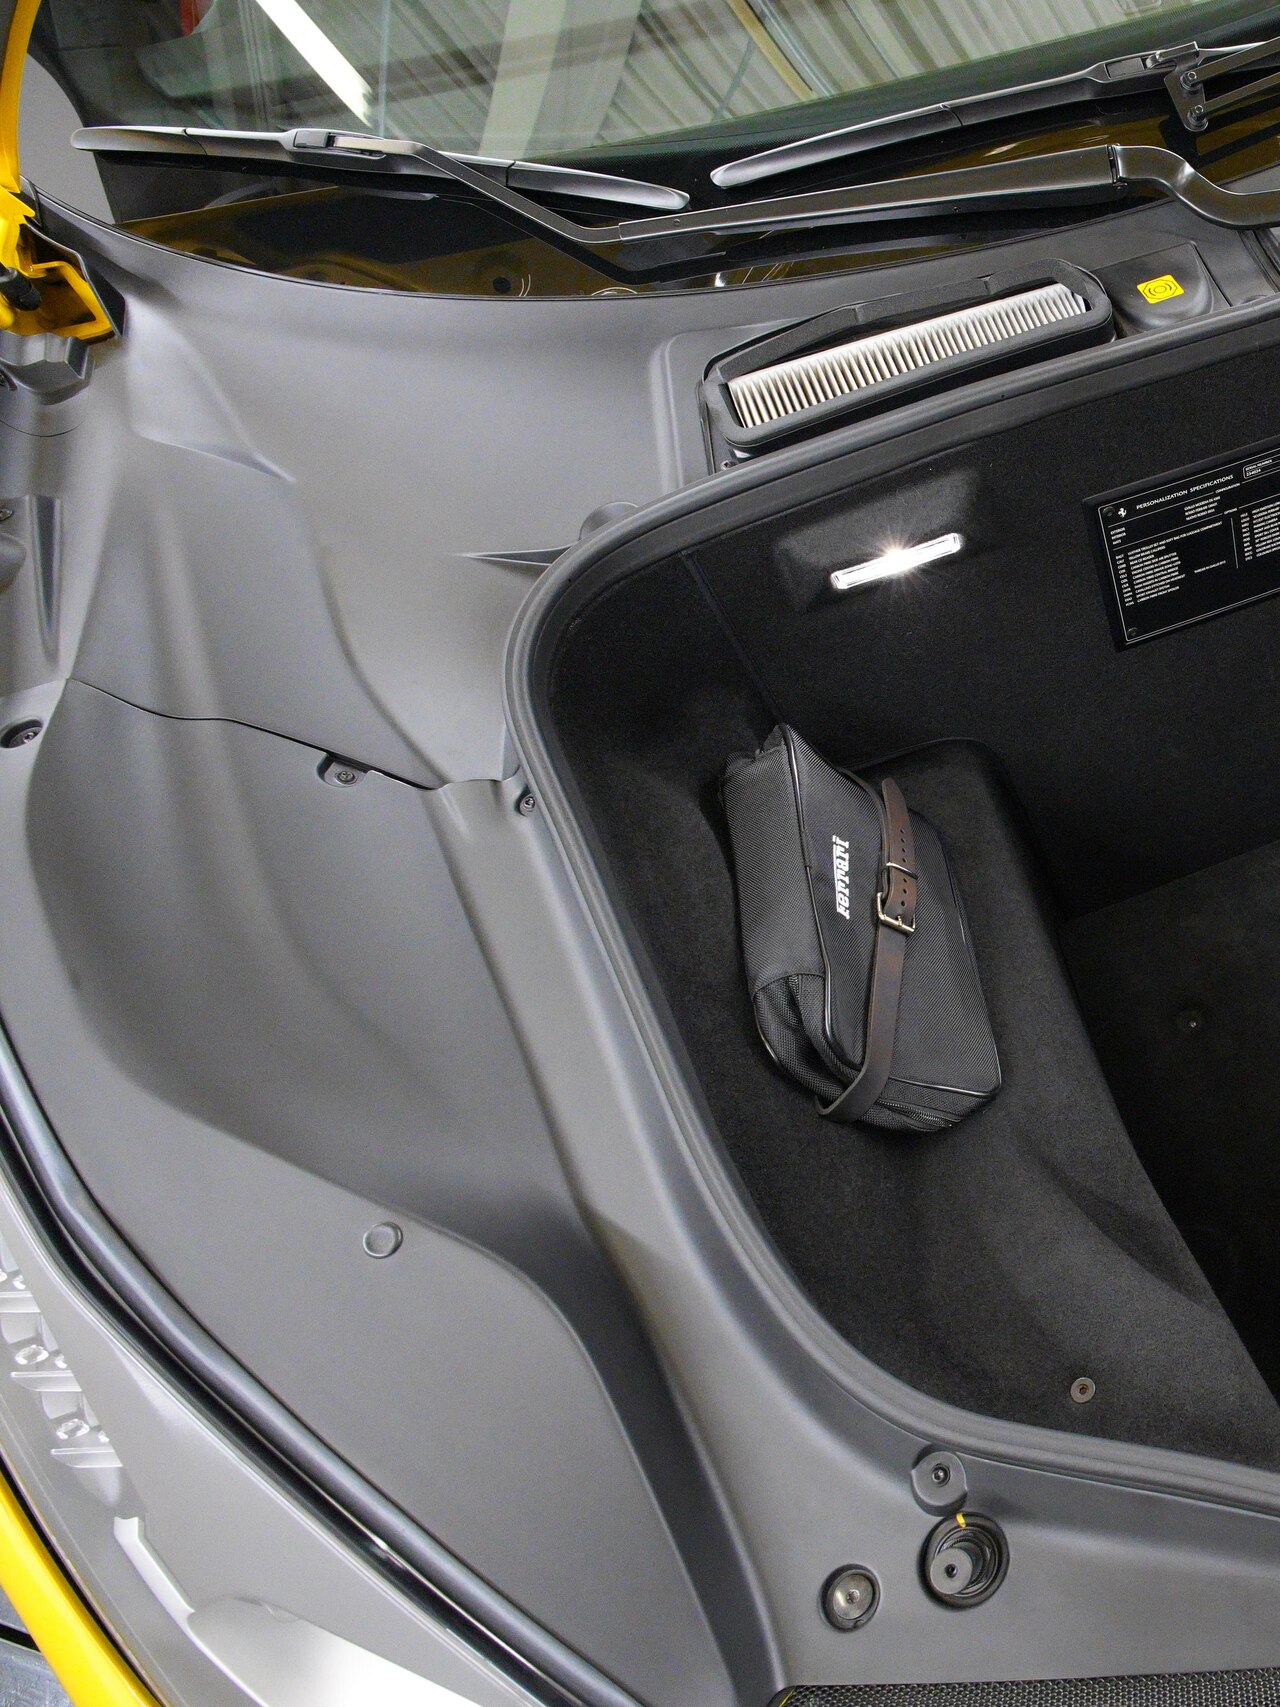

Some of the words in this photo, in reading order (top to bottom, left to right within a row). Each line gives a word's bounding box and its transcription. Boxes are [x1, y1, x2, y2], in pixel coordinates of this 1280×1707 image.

[1137, 489, 1188, 511] PERSONALIZATION
[1190, 474, 1234, 493] SPECIFICATIONS
[832, 835, 850, 920] Ferrari
